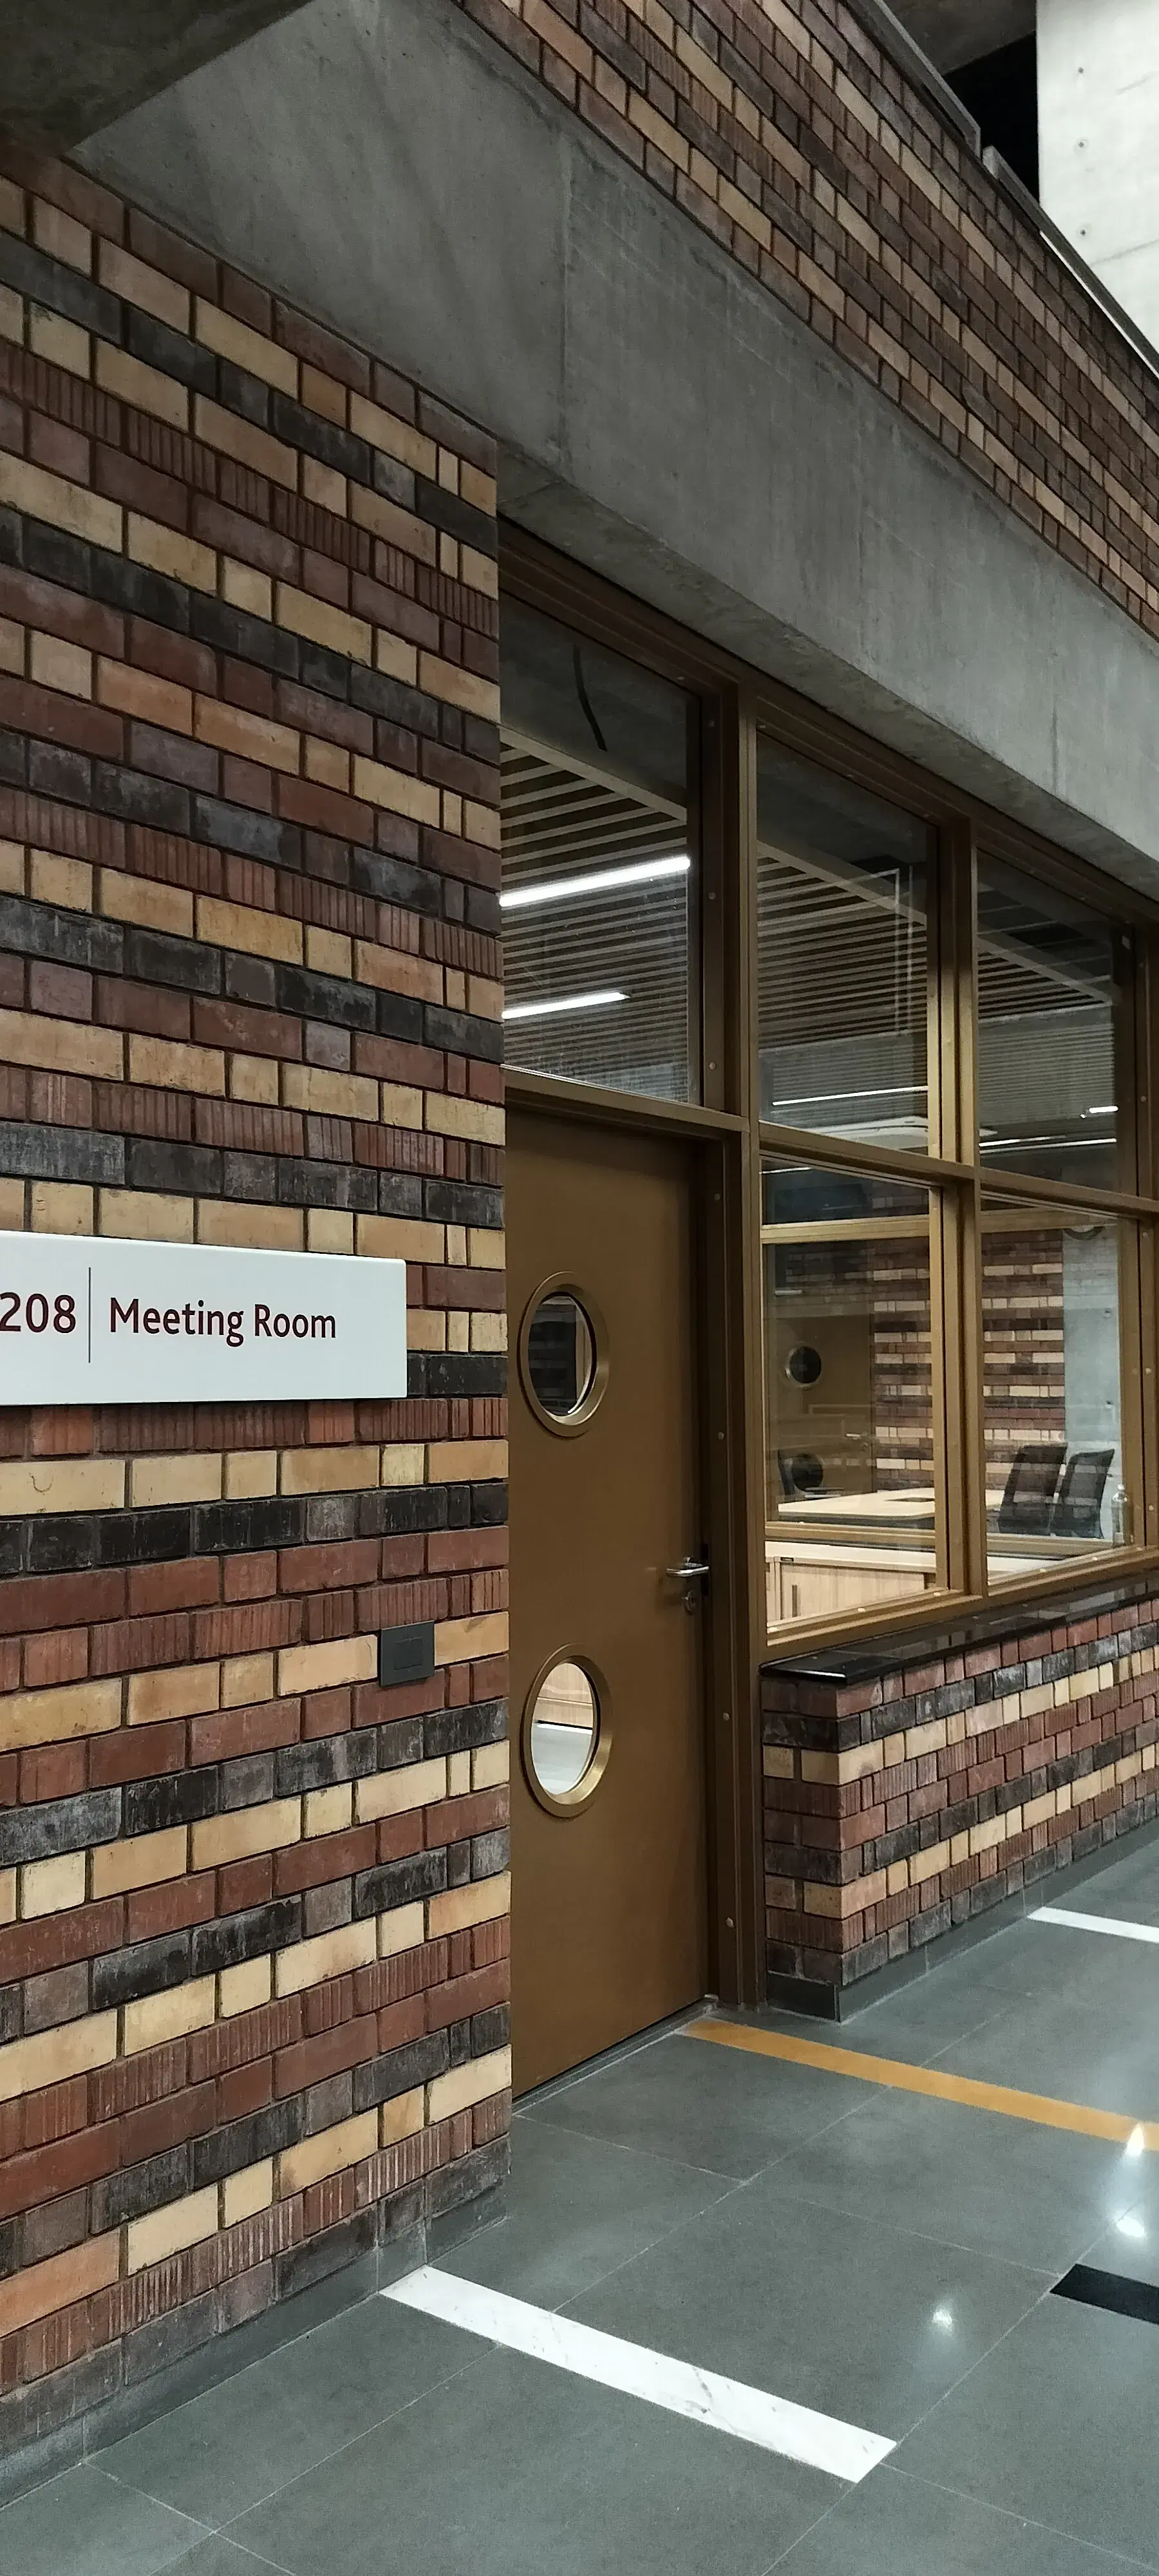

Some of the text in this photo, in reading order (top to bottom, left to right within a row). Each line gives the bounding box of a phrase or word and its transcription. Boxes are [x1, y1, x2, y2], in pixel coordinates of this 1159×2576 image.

[0, 1293, 336, 1347] 208 Meeting Room
